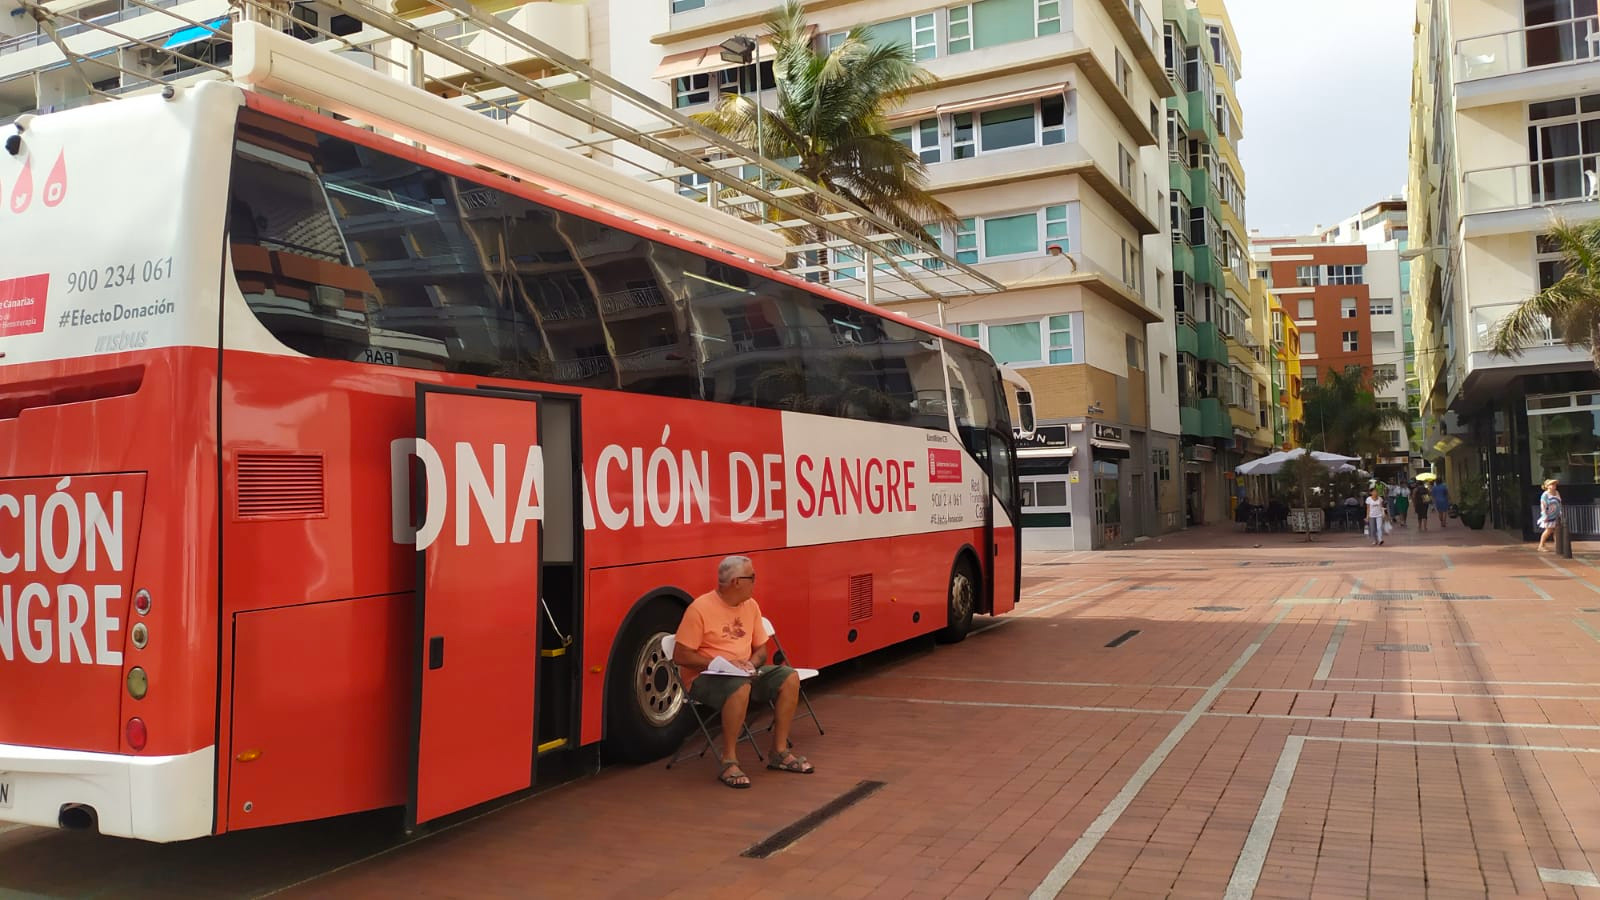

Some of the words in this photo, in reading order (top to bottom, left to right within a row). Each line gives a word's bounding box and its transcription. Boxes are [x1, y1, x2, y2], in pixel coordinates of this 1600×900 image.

[67, 269, 98, 294] 900
[104, 263, 136, 288] 234
[143, 256, 173, 282] 061
[58, 298, 175, 328] #EfectoDonación
[728, 451, 785, 522] DE
[795, 454, 917, 519] SANGRE
